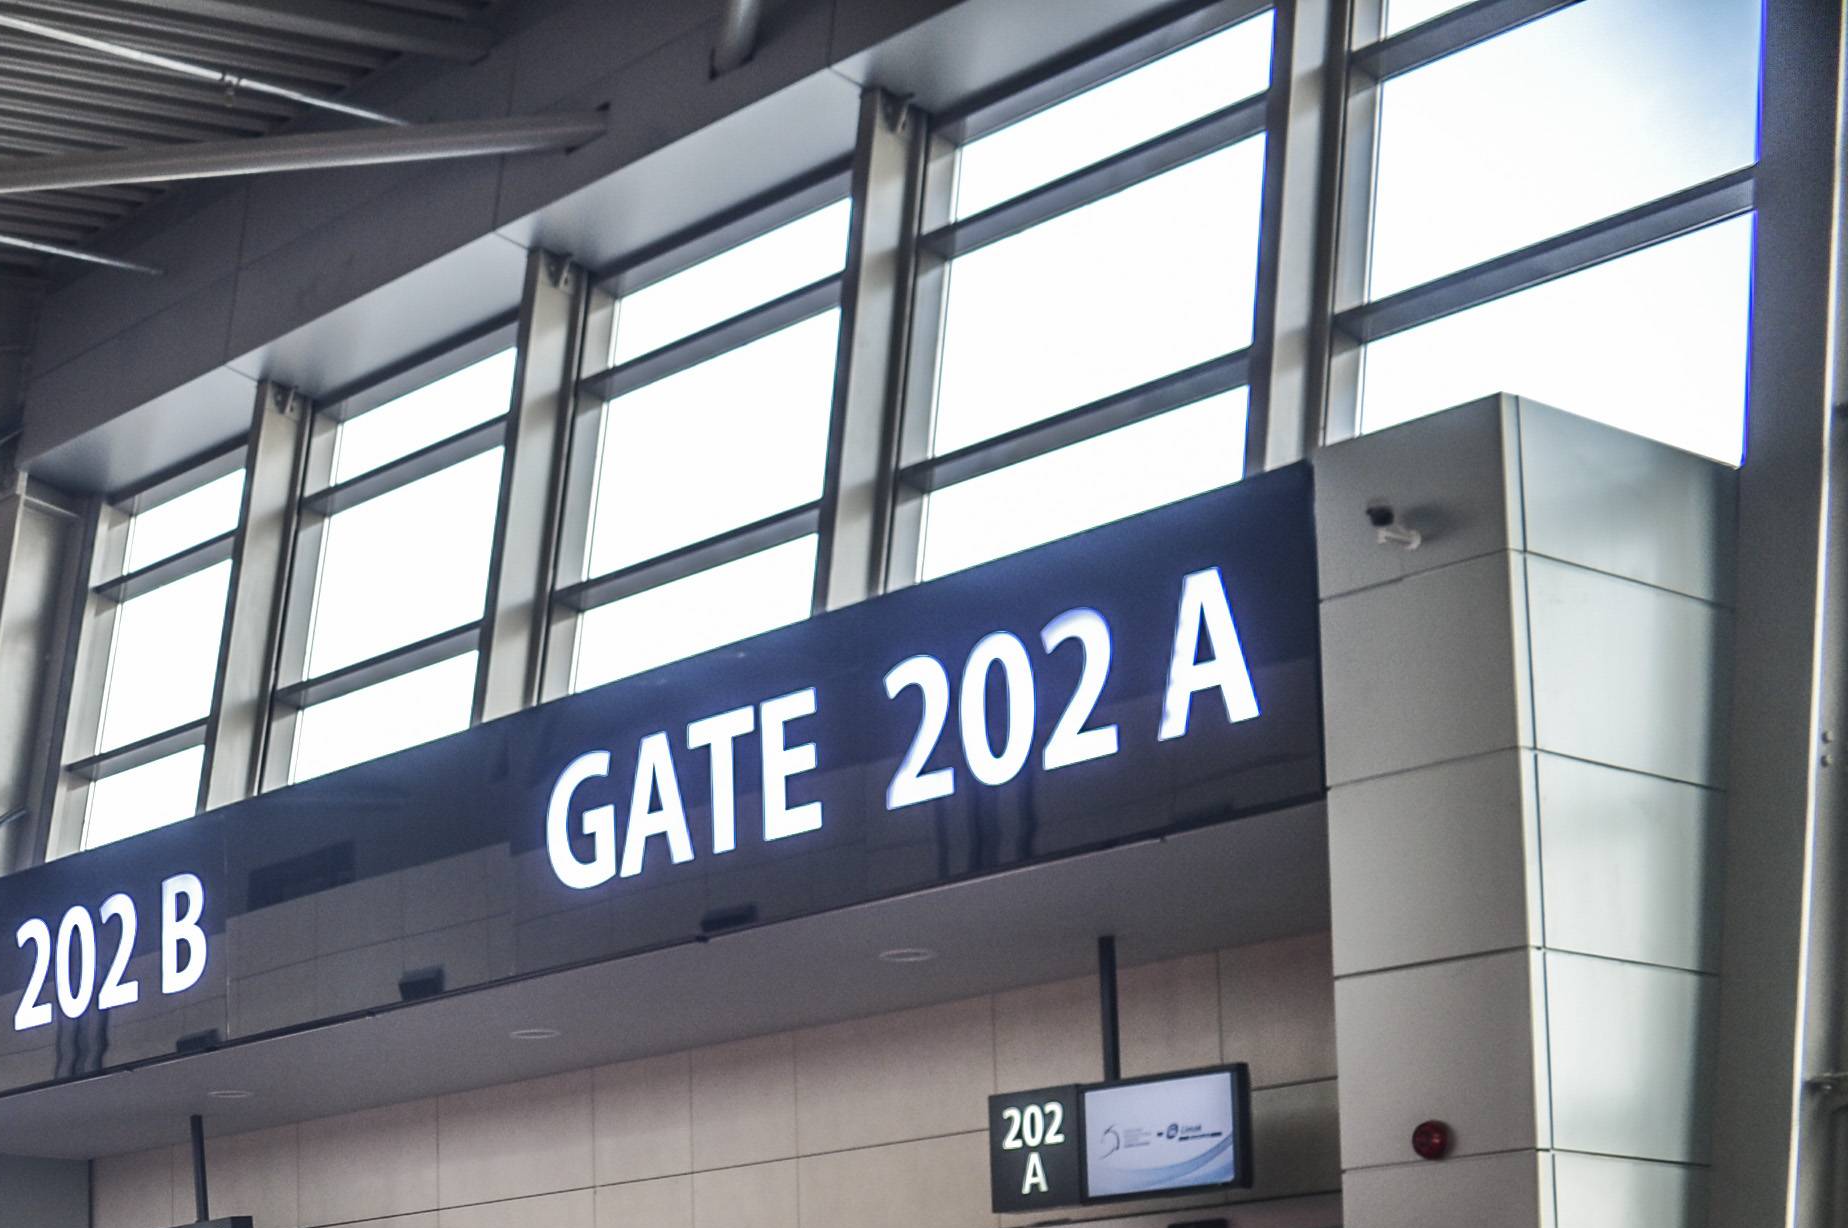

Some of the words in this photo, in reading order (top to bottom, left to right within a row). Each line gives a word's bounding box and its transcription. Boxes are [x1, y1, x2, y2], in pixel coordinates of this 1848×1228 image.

[545, 687, 824, 890] GATE
[883, 611, 1120, 809] 202
[1159, 568, 1261, 741] A
[13, 892, 140, 1032] 202
[161, 872, 211, 995] B
[1002, 1100, 1065, 1151] 202
[1021, 1152, 1049, 1196] A
